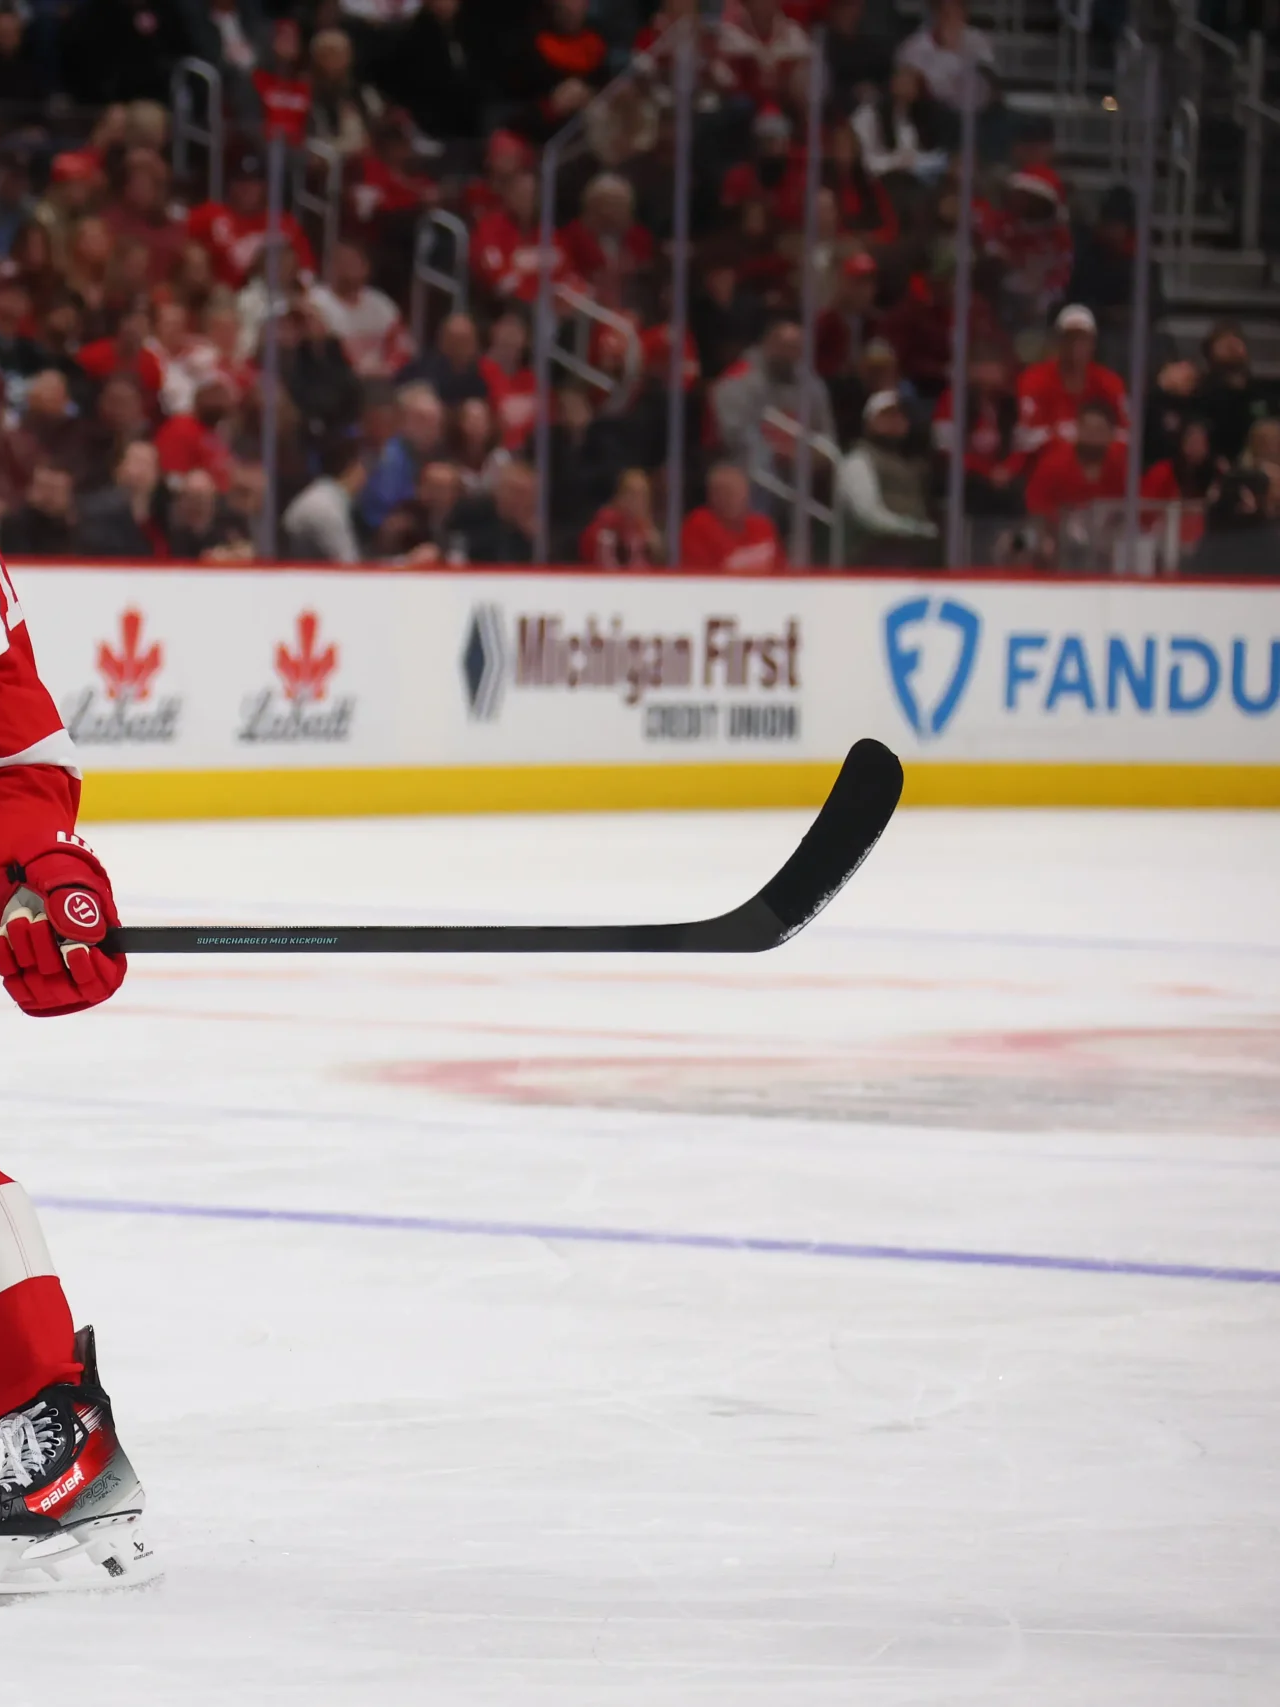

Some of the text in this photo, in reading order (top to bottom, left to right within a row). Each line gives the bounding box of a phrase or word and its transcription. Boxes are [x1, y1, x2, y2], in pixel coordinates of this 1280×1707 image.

[516, 614, 801, 706] Michigan First
[1004, 634, 1280, 714] FANDU
[729, 703, 799, 740] UNION
[196, 937, 268, 945] SUPERCHARGED
